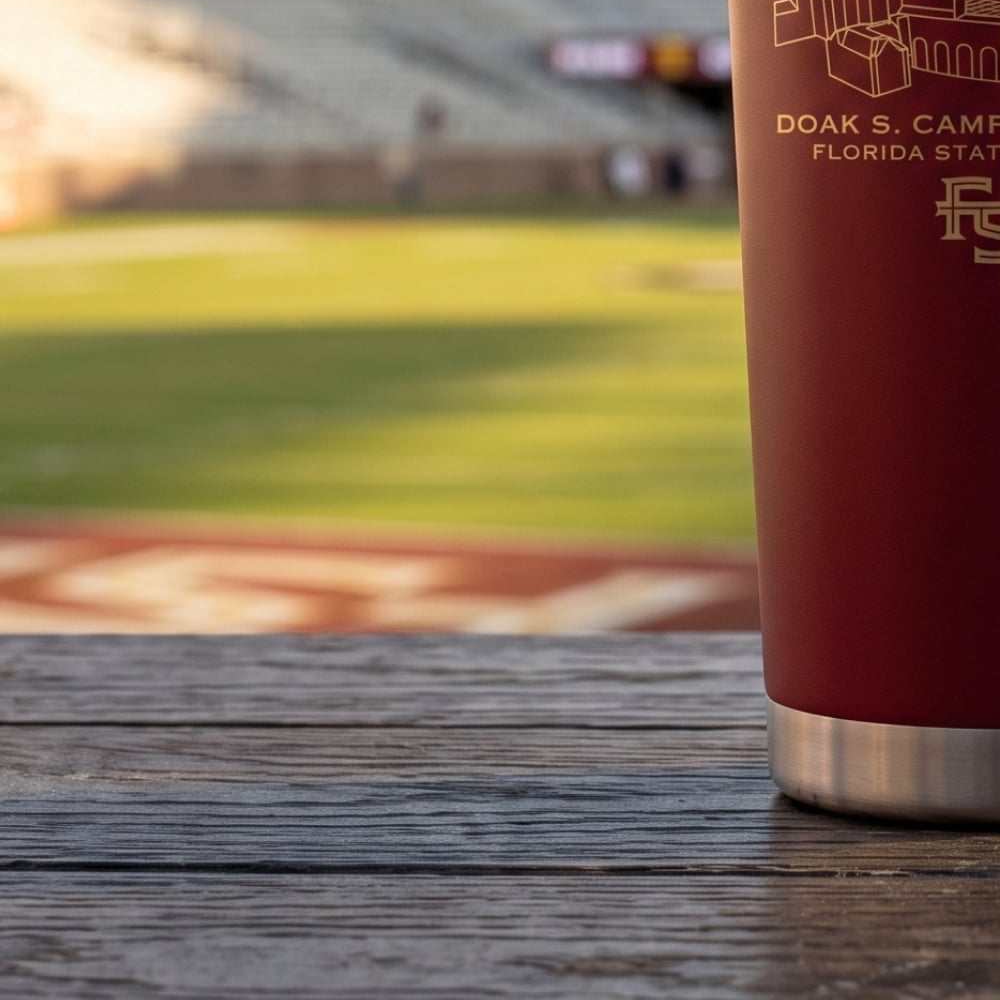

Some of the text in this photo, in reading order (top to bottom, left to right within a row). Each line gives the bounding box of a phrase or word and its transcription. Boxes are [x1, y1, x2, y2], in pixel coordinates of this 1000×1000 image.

[776, 114, 860, 134] DOAK
[871, 114, 900, 134] S.
[812, 144, 924, 160] FLORIDA
